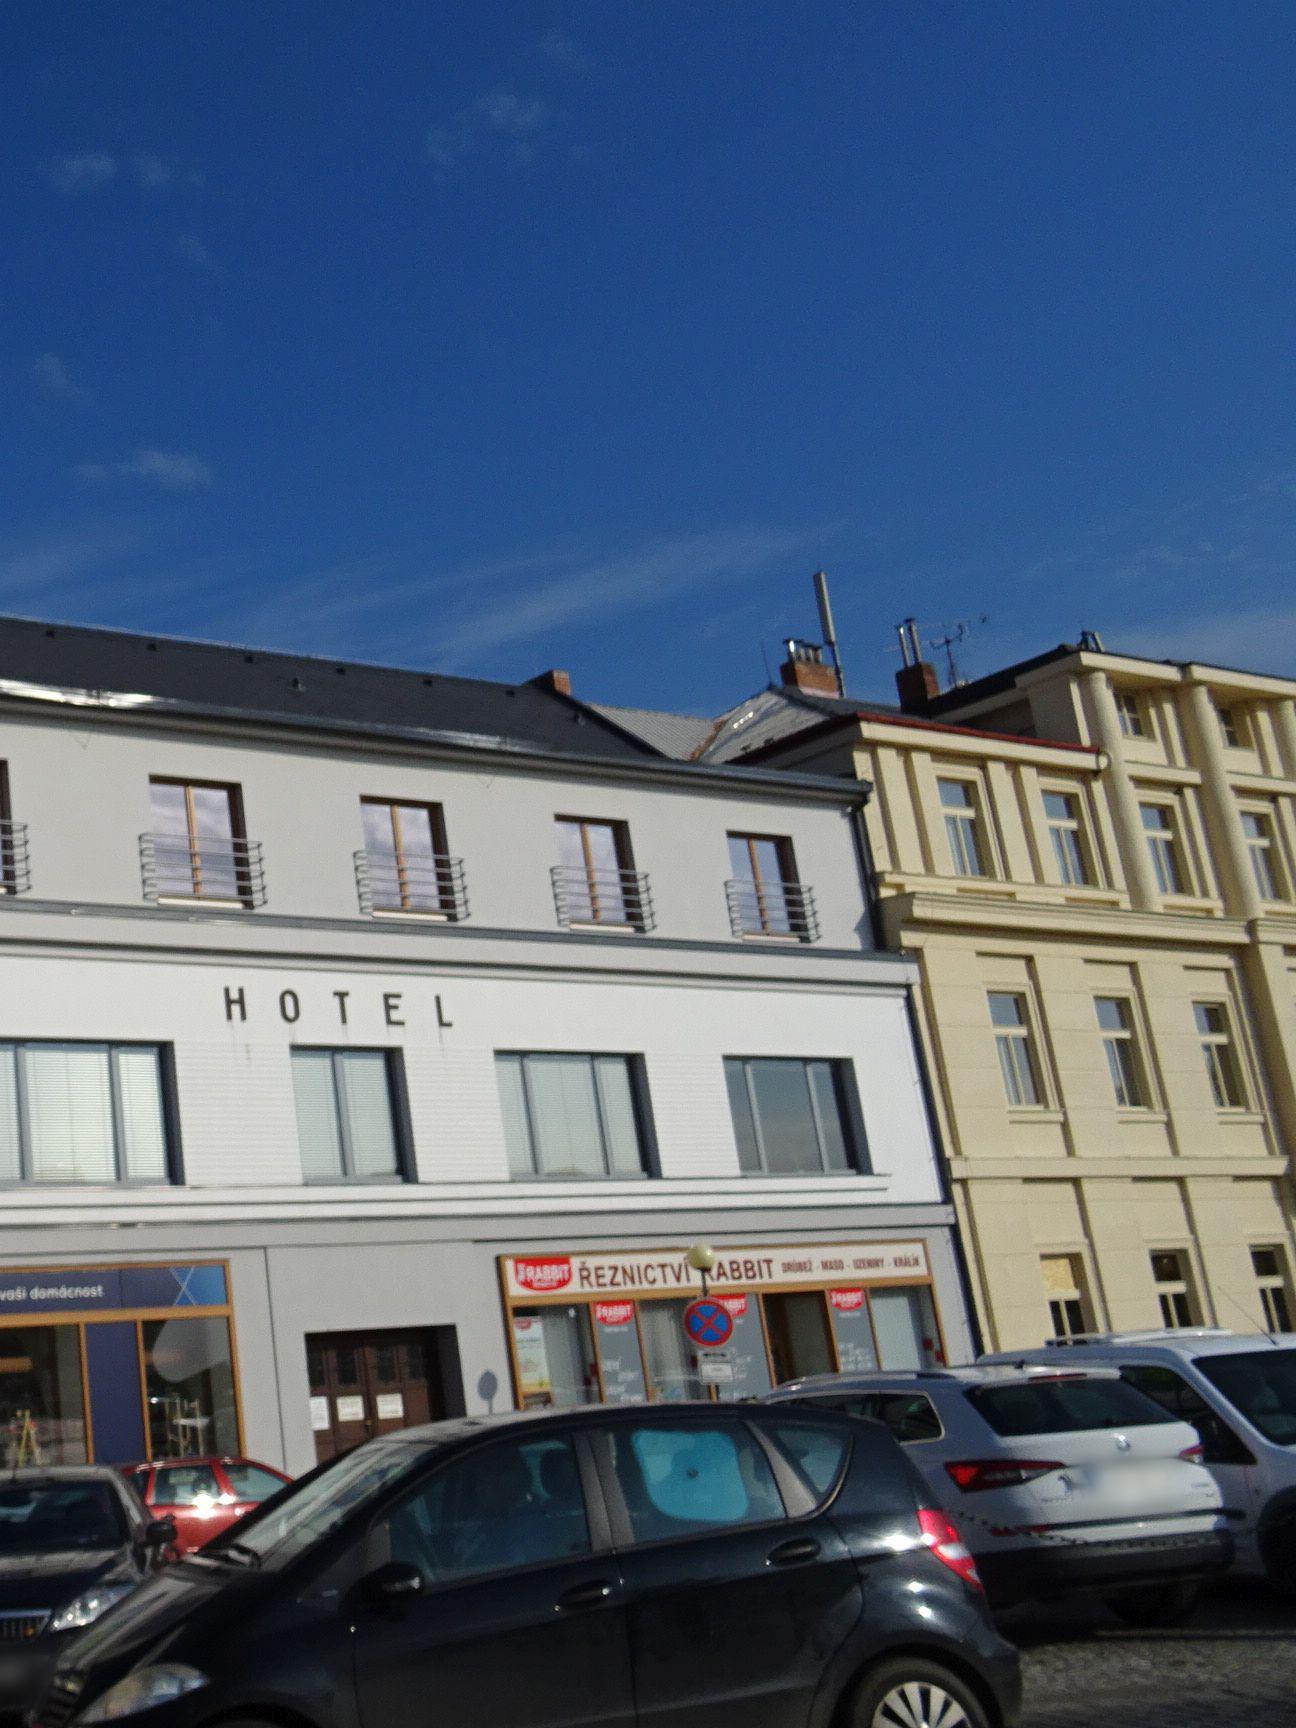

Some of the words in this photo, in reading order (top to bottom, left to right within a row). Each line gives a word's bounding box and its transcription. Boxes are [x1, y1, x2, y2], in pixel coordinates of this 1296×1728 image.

[224, 986, 453, 1027] HOTEL
[579, 1258, 691, 1289] ŘEZNICTVÍ
[0, 1286, 27, 1301] vaši
[30, 1284, 104, 1300] domácnost
